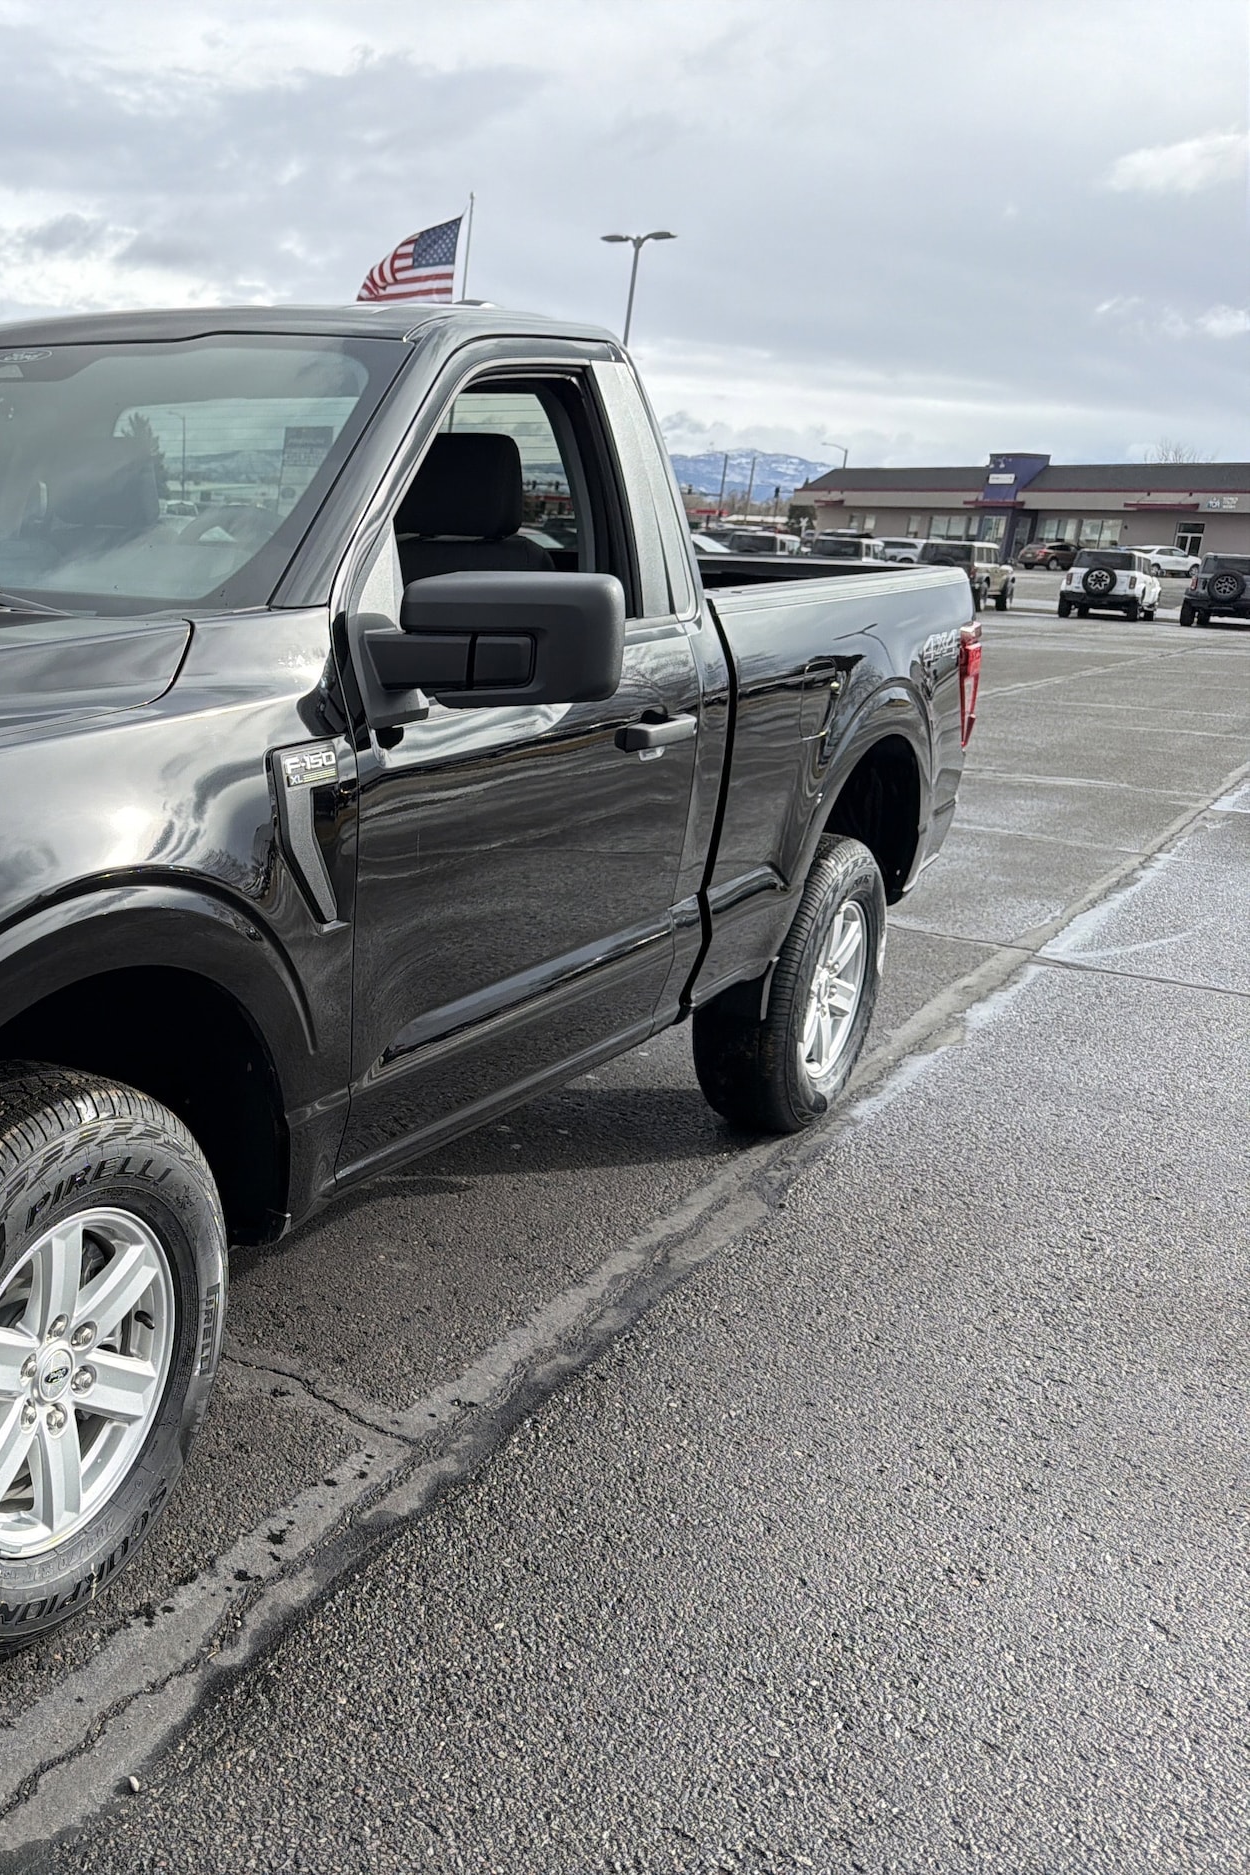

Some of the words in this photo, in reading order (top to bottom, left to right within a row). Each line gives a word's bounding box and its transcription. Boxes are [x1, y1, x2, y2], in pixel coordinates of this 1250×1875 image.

[285, 751, 336, 775] F-150
[290, 775, 303, 786] XL
[25, 1155, 174, 1233] PIRELLI
